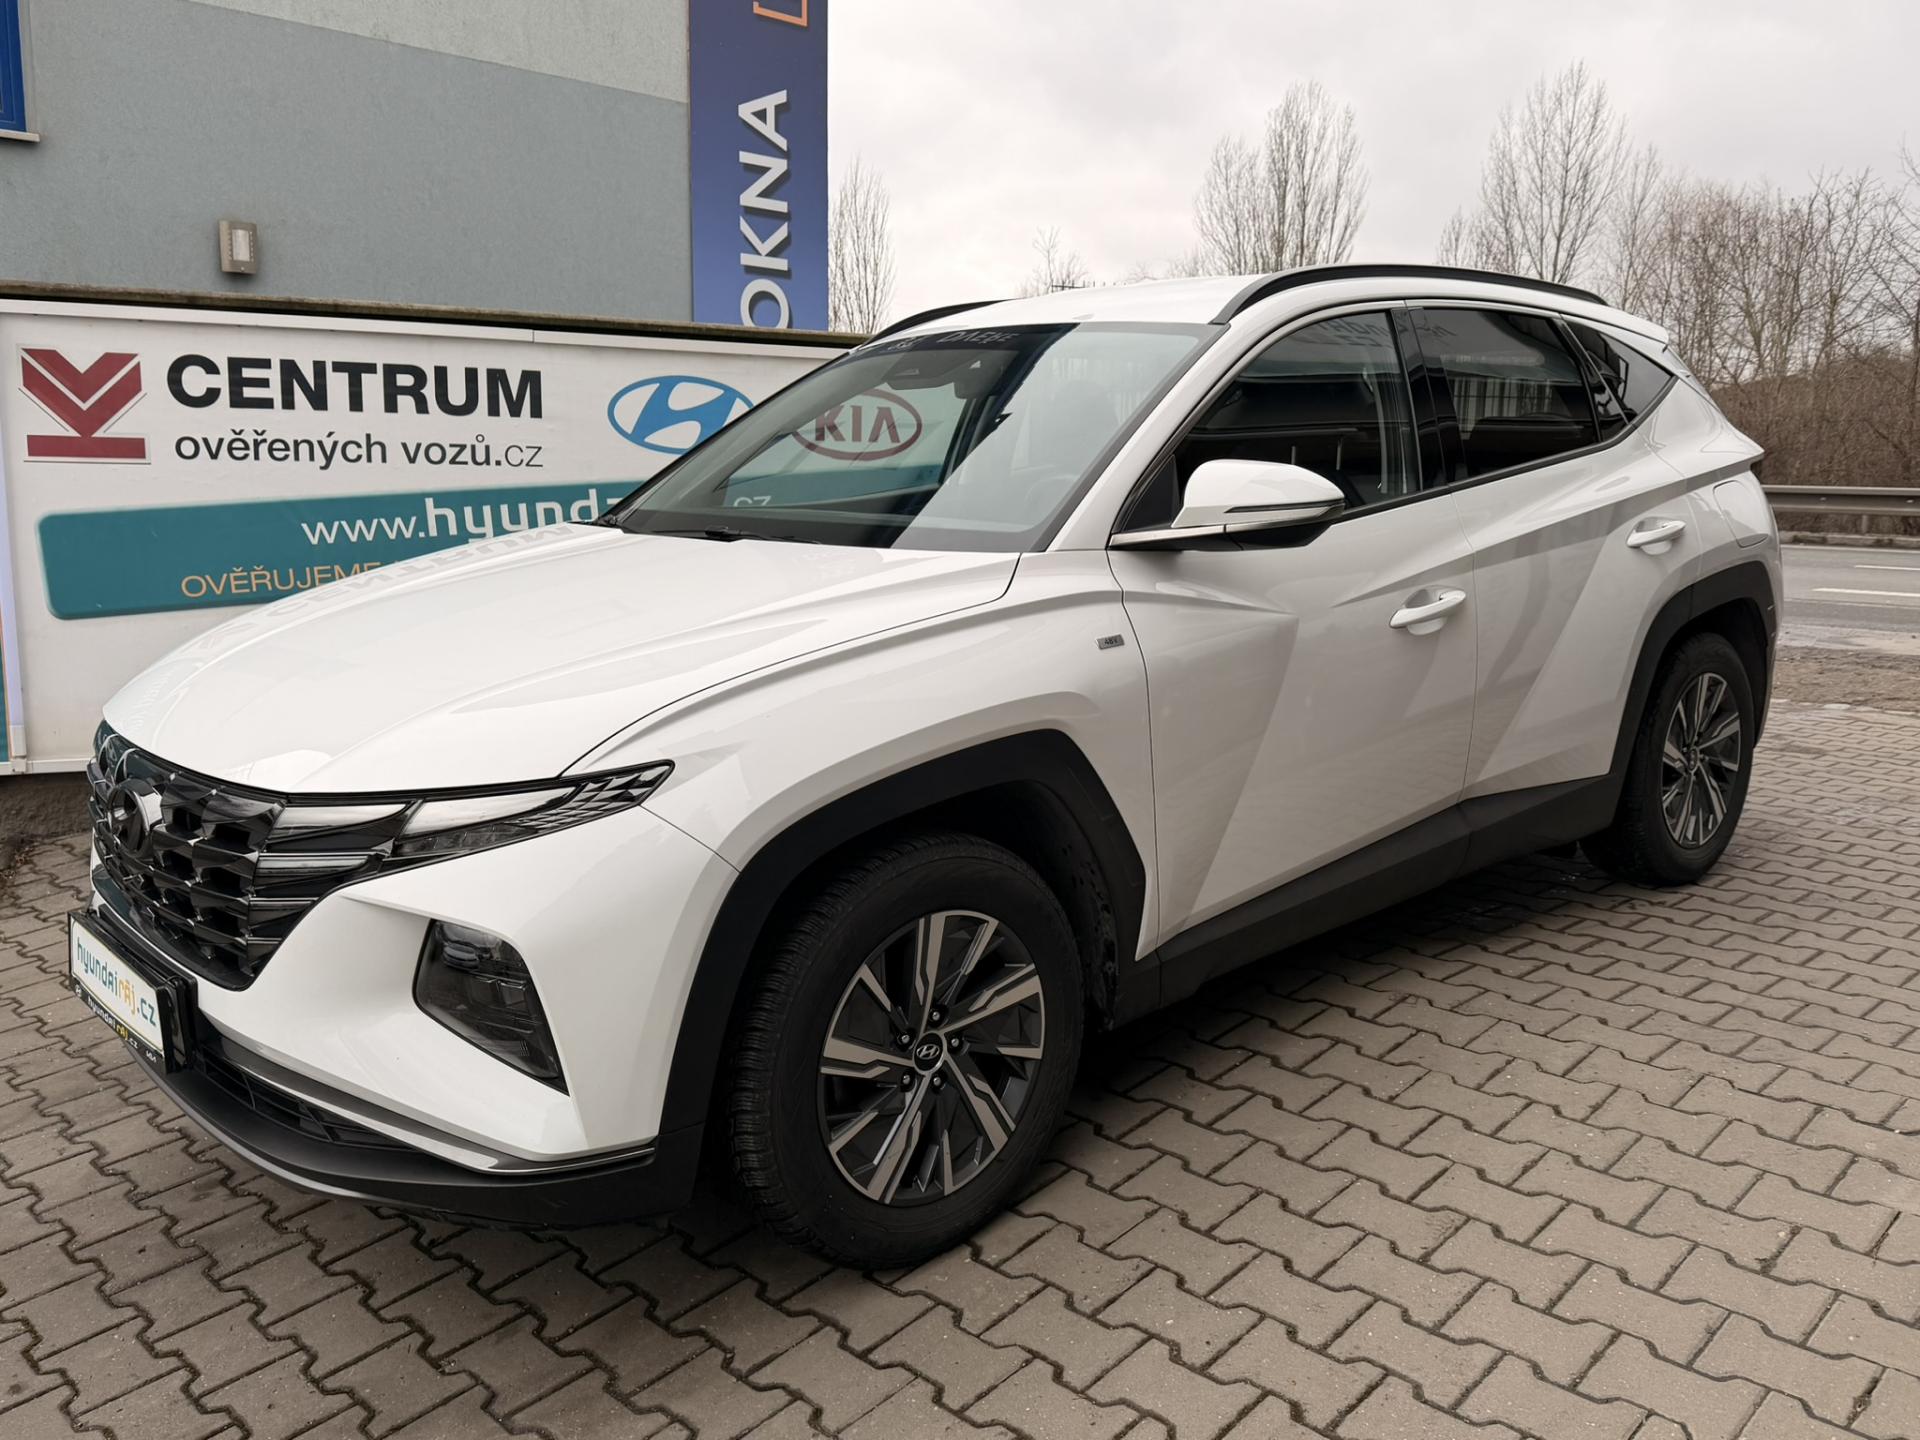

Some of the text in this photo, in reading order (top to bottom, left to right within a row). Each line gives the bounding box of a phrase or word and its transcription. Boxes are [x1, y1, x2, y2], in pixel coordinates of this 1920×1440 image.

[738, 89, 790, 329] OKNA
[166, 353, 543, 419] CENTRUM
[174, 428, 388, 470] ověřených
[814, 404, 901, 443] KIA
[301, 488, 624, 544] www.hyund
